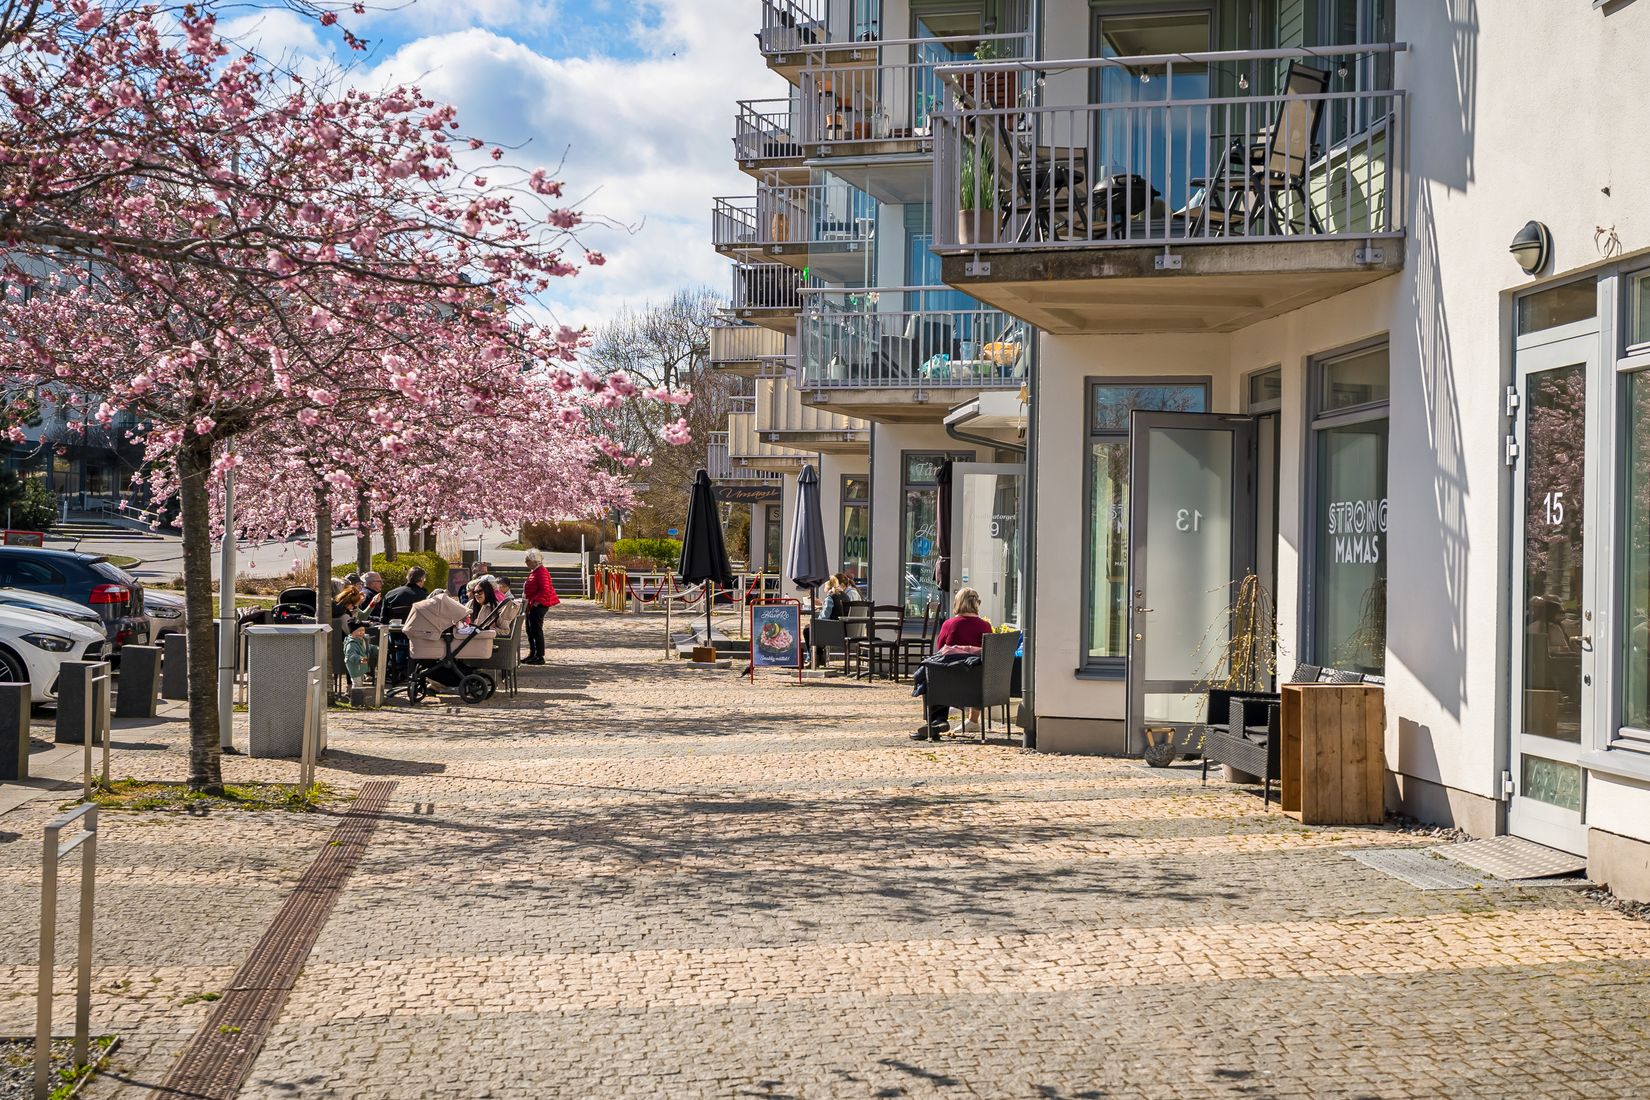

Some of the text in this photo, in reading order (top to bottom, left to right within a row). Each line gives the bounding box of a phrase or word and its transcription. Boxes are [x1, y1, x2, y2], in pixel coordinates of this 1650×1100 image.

[1328, 498, 1387, 534] STRONG
[1543, 491, 1564, 525] 15
[990, 521, 999, 537] 9
[1335, 535, 1379, 564] MAMAS
